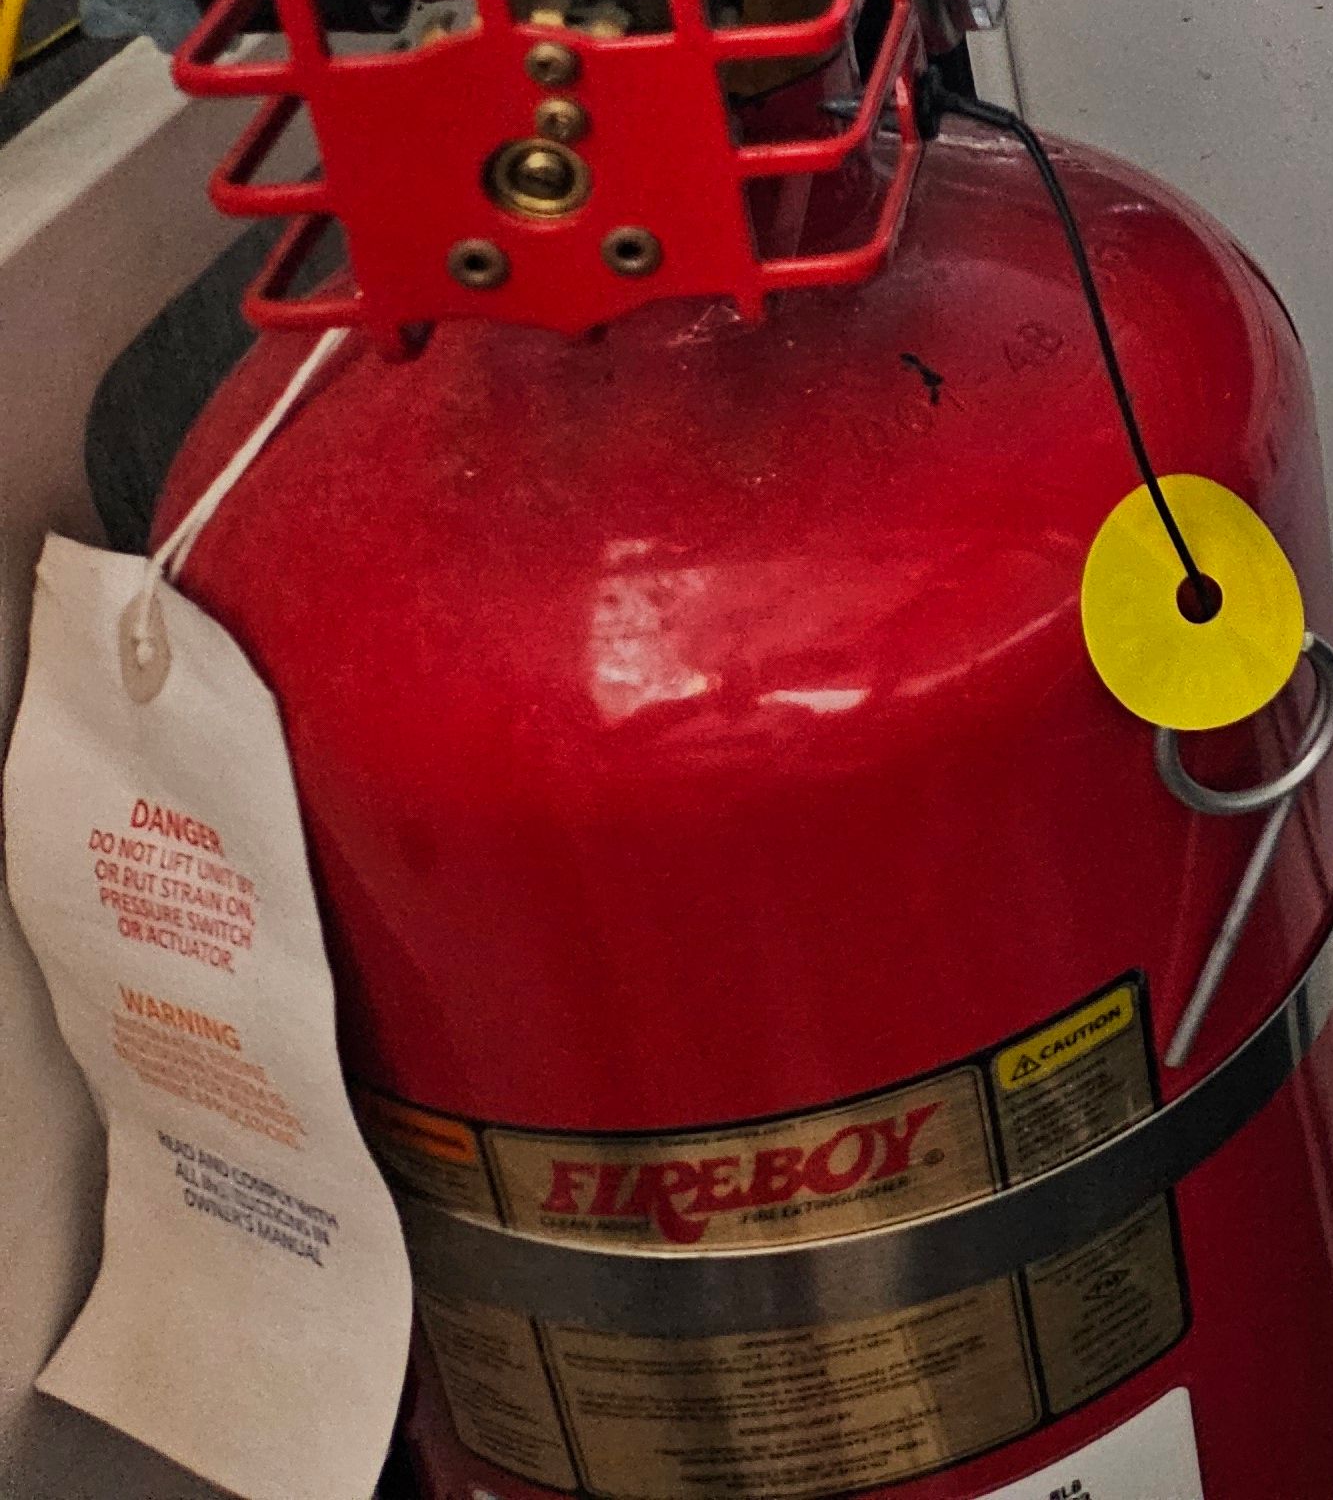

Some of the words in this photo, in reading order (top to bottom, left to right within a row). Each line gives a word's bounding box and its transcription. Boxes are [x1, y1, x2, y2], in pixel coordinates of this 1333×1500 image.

[88, 829, 114, 852] DO
[118, 838, 157, 865] NOT
[161, 847, 193, 876] LIFT
[130, 799, 224, 857] DANGER
[94, 859, 120, 884] OR
[187, 913, 253, 949] SWITCH
[119, 983, 241, 1051] WARNING
[1040, 1005, 1121, 1059] CAUTION
[540, 1101, 945, 1244] FIREBOY
